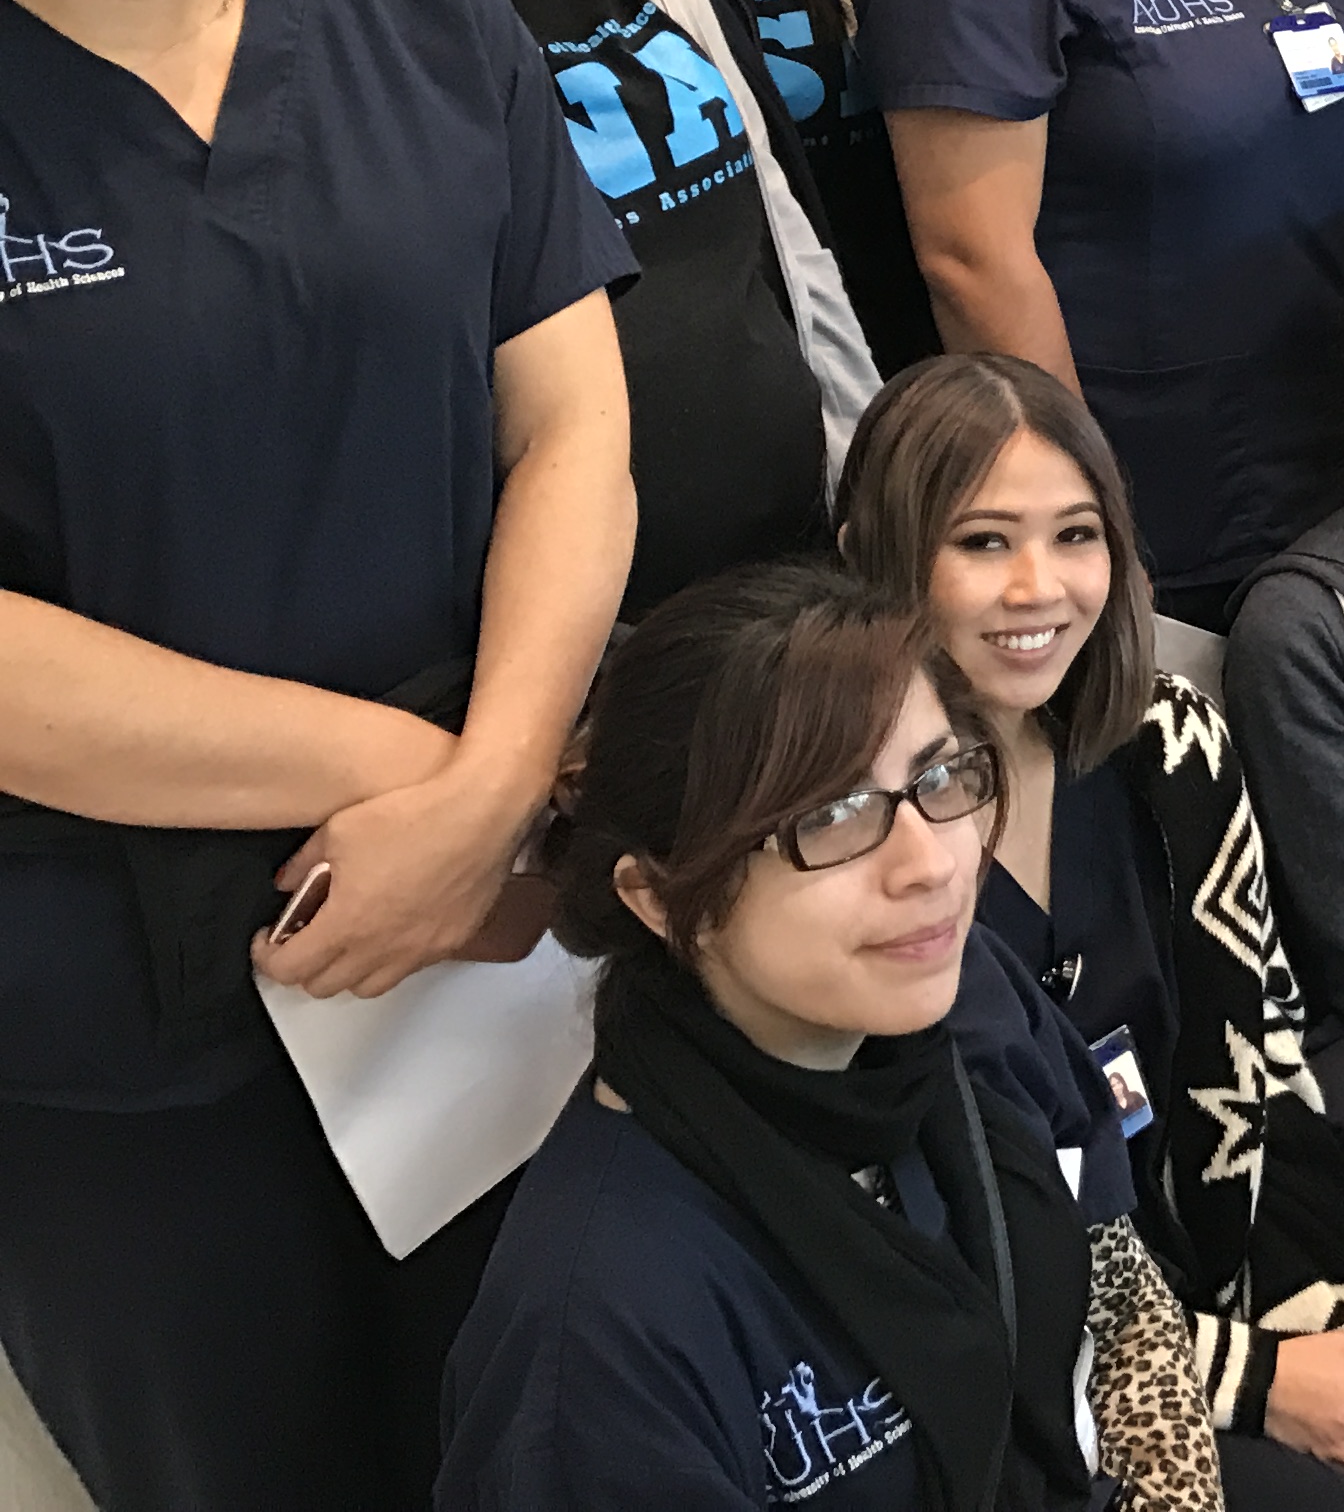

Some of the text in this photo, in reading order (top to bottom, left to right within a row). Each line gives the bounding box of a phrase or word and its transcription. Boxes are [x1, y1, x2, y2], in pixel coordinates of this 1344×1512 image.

[555, 30, 744, 200] NA
[658, 150, 754, 213] Associat
[0, 228, 115, 283] HS
[9, 282, 23, 298] of
[26, 276, 70, 294] Health
[72, 267, 126, 285] Sciences
[884, 1418, 913, 1445] Scien
